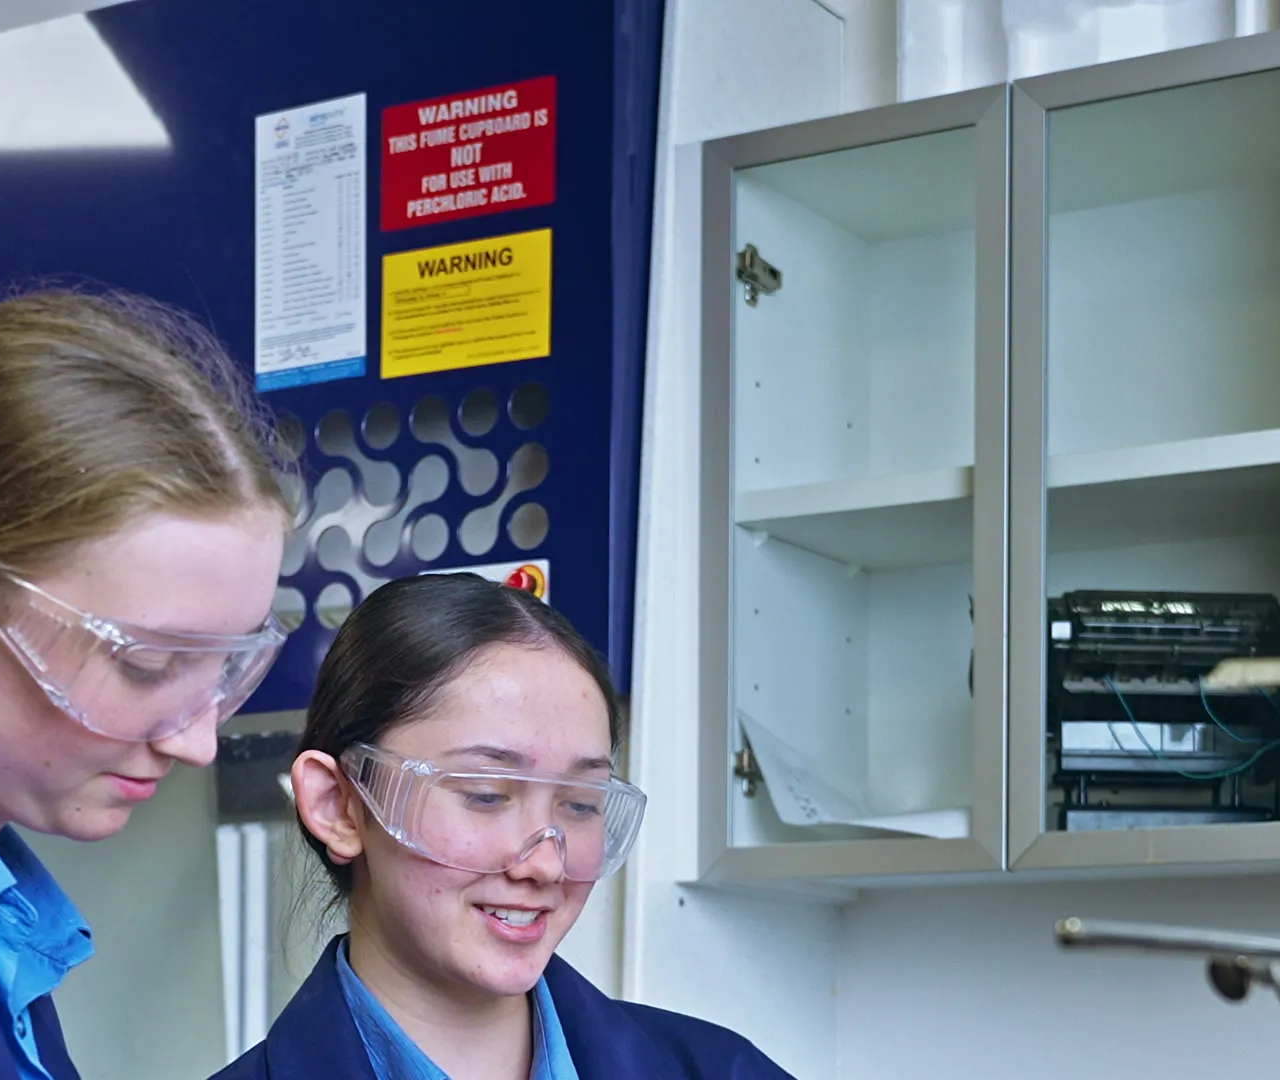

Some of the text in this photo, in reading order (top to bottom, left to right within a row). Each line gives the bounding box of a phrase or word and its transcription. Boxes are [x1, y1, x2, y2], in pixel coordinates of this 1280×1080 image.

[418, 90, 518, 126] WARNING
[388, 108, 548, 154] THIS FUME CUPBOARD IS
[450, 142, 483, 167] NOT
[421, 161, 512, 194] FOR USE WITH
[406, 182, 527, 218] PERCHLORIC ACID.
[417, 247, 513, 279] WARNING
